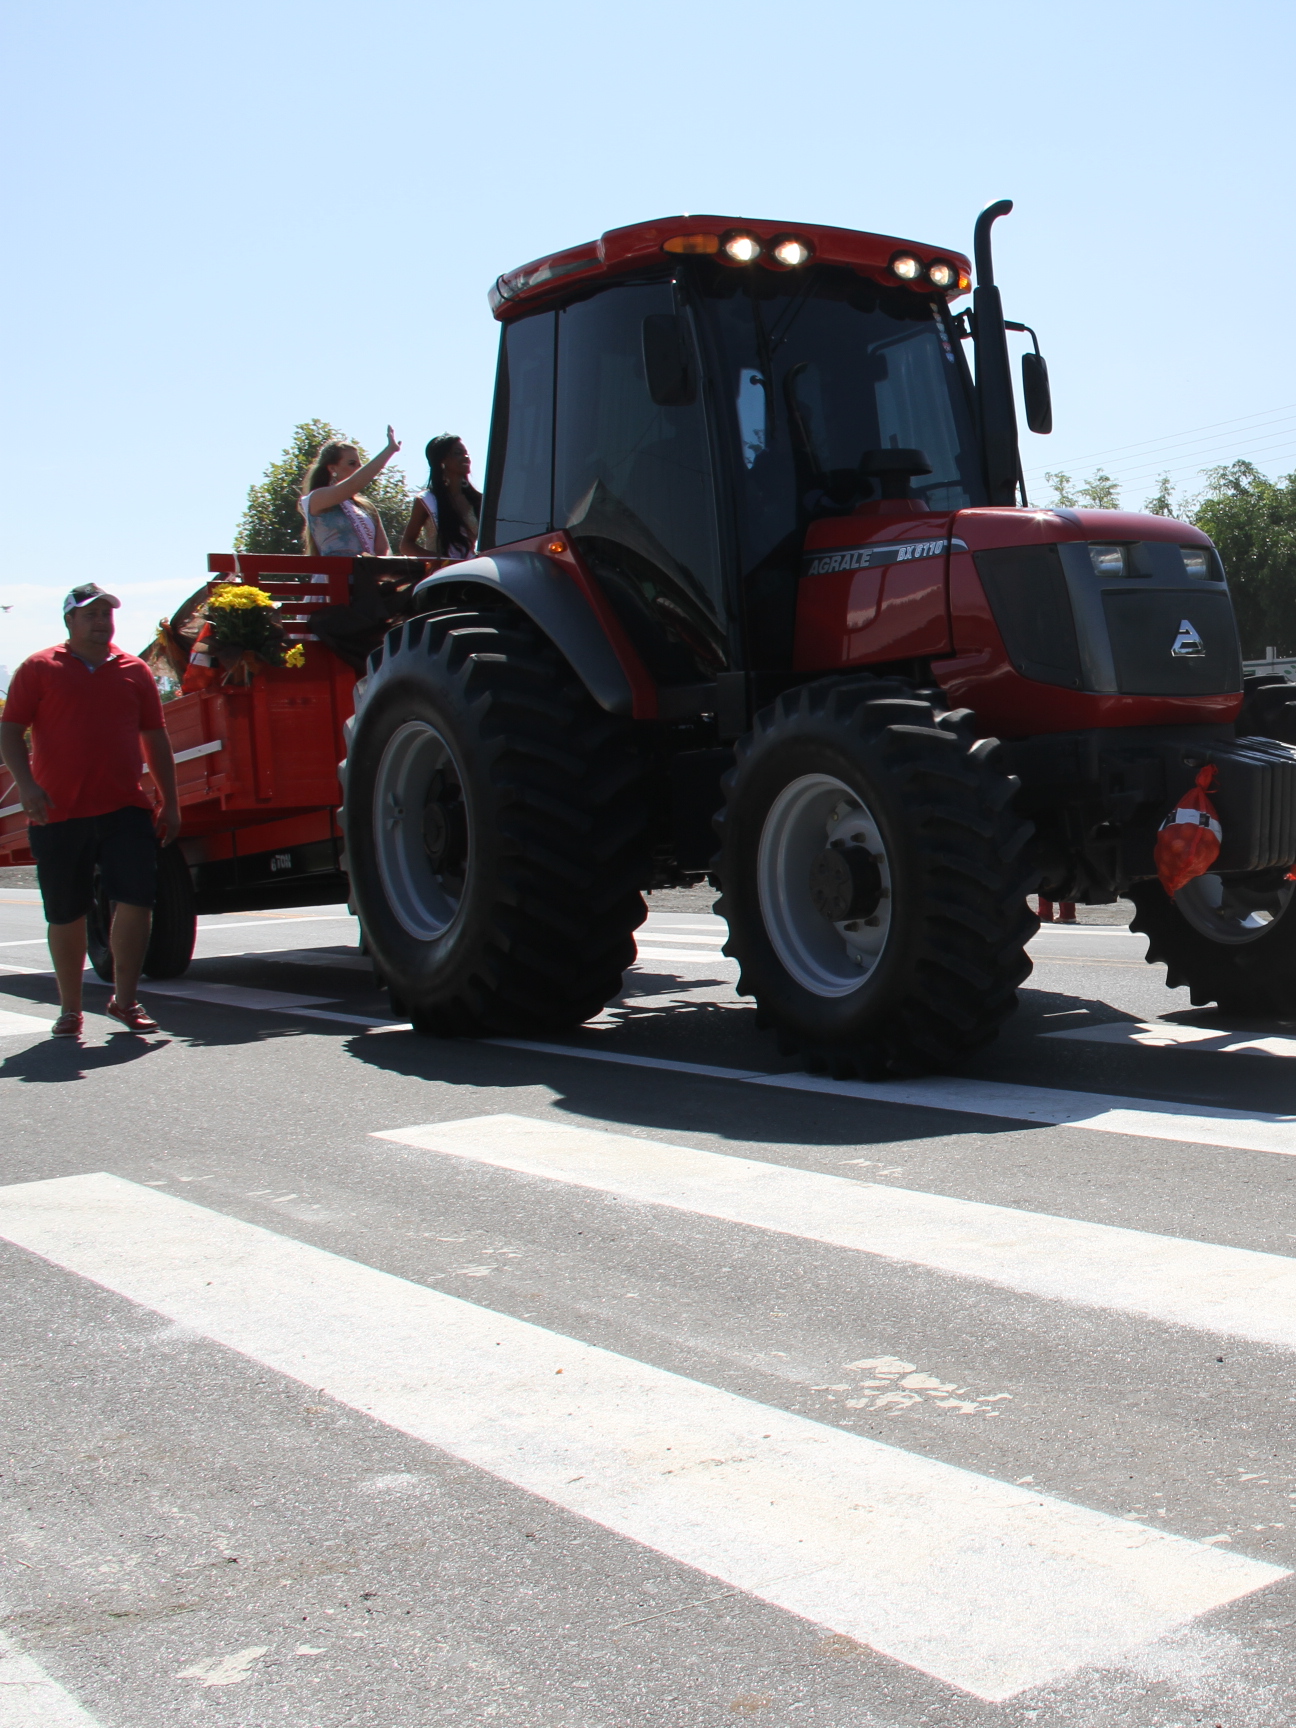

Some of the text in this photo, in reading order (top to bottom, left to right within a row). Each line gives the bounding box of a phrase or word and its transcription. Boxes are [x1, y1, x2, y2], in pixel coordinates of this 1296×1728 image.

[808, 540, 944, 576] AGRALE BX 6110
